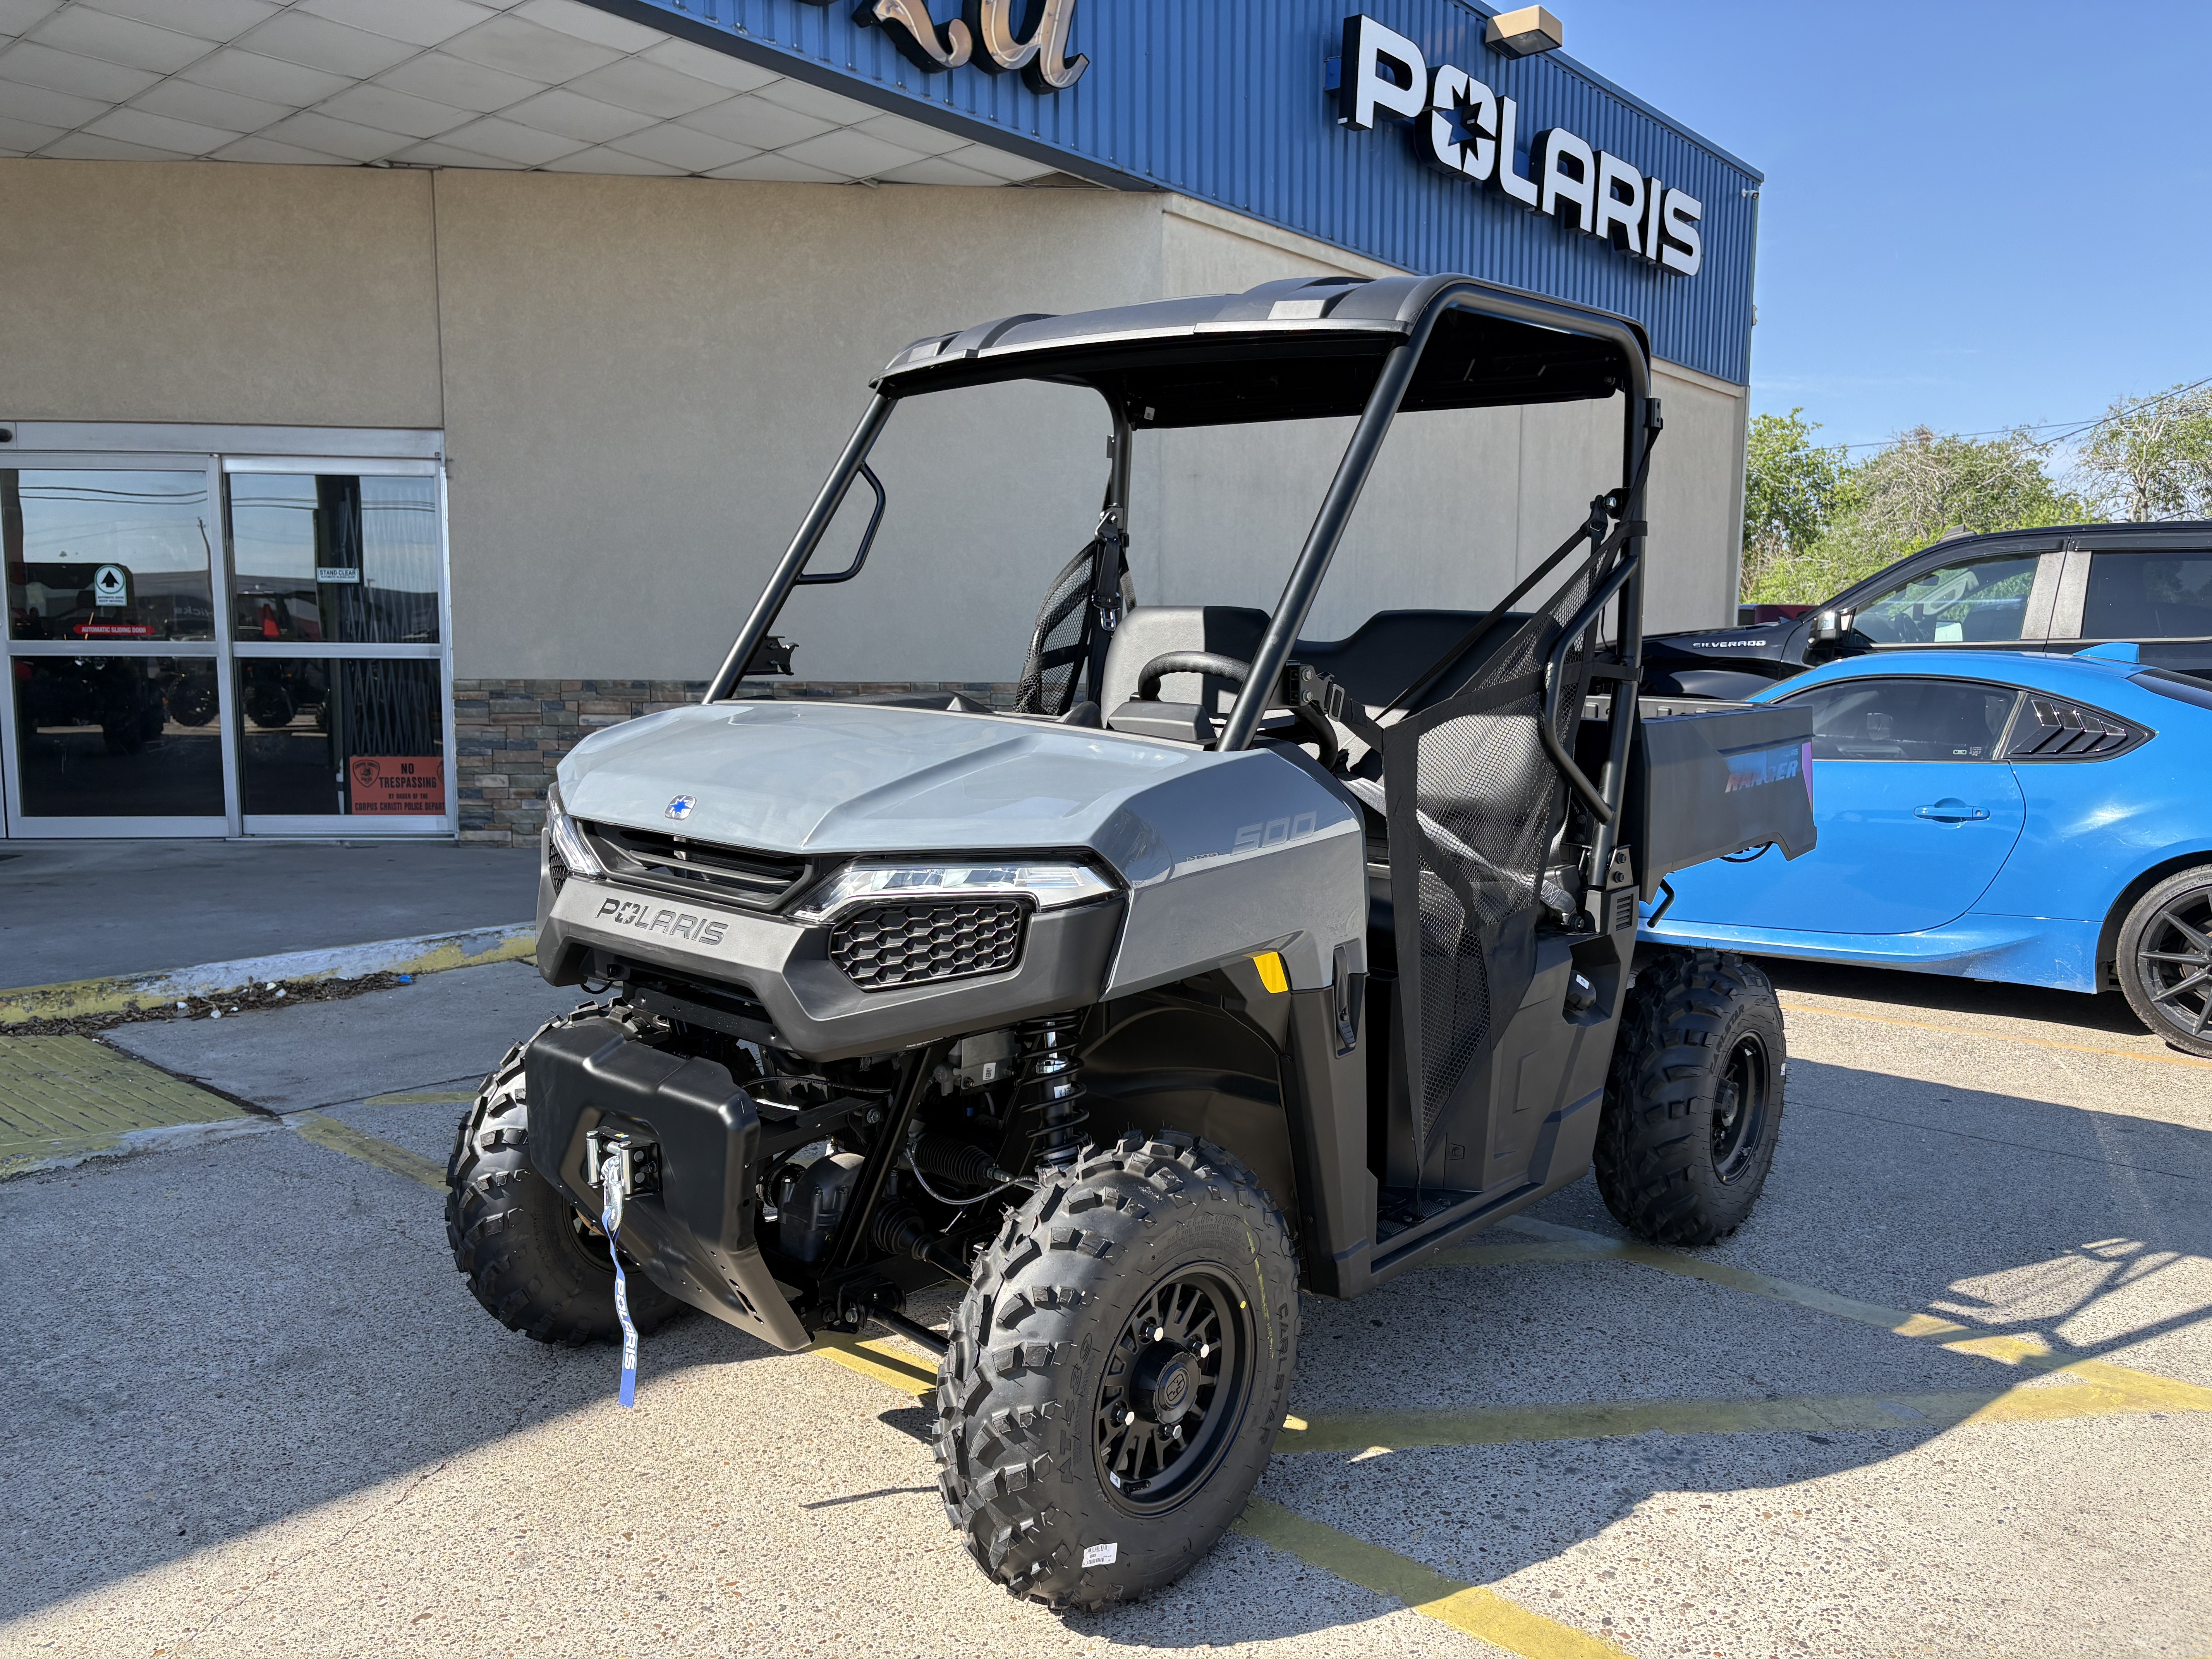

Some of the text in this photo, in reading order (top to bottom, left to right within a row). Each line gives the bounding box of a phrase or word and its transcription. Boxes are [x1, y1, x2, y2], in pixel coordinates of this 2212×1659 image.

[1354, 14, 1702, 276] POLARIS
[1693, 640, 1766, 649] SILVERADO
[379, 777, 437, 788] TRESPASSING
[401, 763, 414, 775] NO
[1724, 760, 1798, 793] RANGER
[355, 802, 378, 811] CORPUS
[380, 802, 402, 811] CHRISTI
[404, 802, 422, 811] POLICE
[1230, 811, 1317, 856] 500
[594, 898, 729, 946] POLARIS
[616, 1278, 636, 1370] POLARIS
[1259, 1302, 1289, 1445] CARLSTAR
